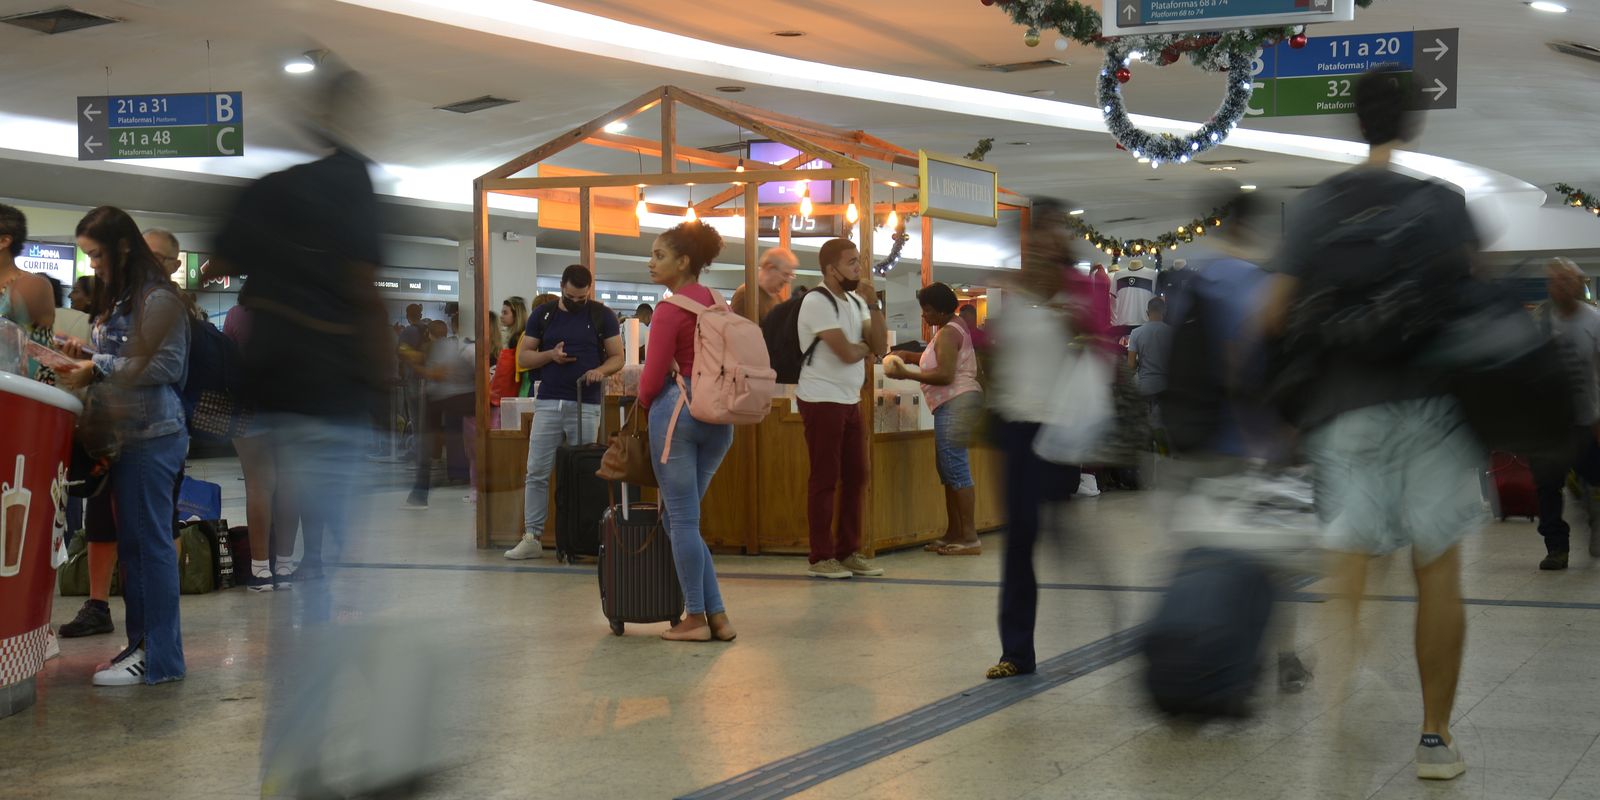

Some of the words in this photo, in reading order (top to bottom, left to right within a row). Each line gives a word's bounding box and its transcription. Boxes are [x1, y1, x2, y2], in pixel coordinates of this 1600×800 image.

[1151, 1, 1198, 10] Plataformas
[1329, 41, 1350, 58] 11
[1357, 43, 1369, 56] a
[1375, 37, 1400, 55] 20
[1317, 61, 1365, 71] Plataformas
[1327, 80, 1351, 97] 32
[118, 99, 134, 114] 21
[139, 103, 148, 113] a
[151, 98, 168, 113] 31
[215, 94, 234, 123] B
[118, 132, 136, 146] 41
[140, 134, 149, 145] a
[152, 130, 171, 145] 48
[216, 126, 235, 155] C
[930, 175, 940, 193] LA
[23, 260, 59, 270] CURITIBA
